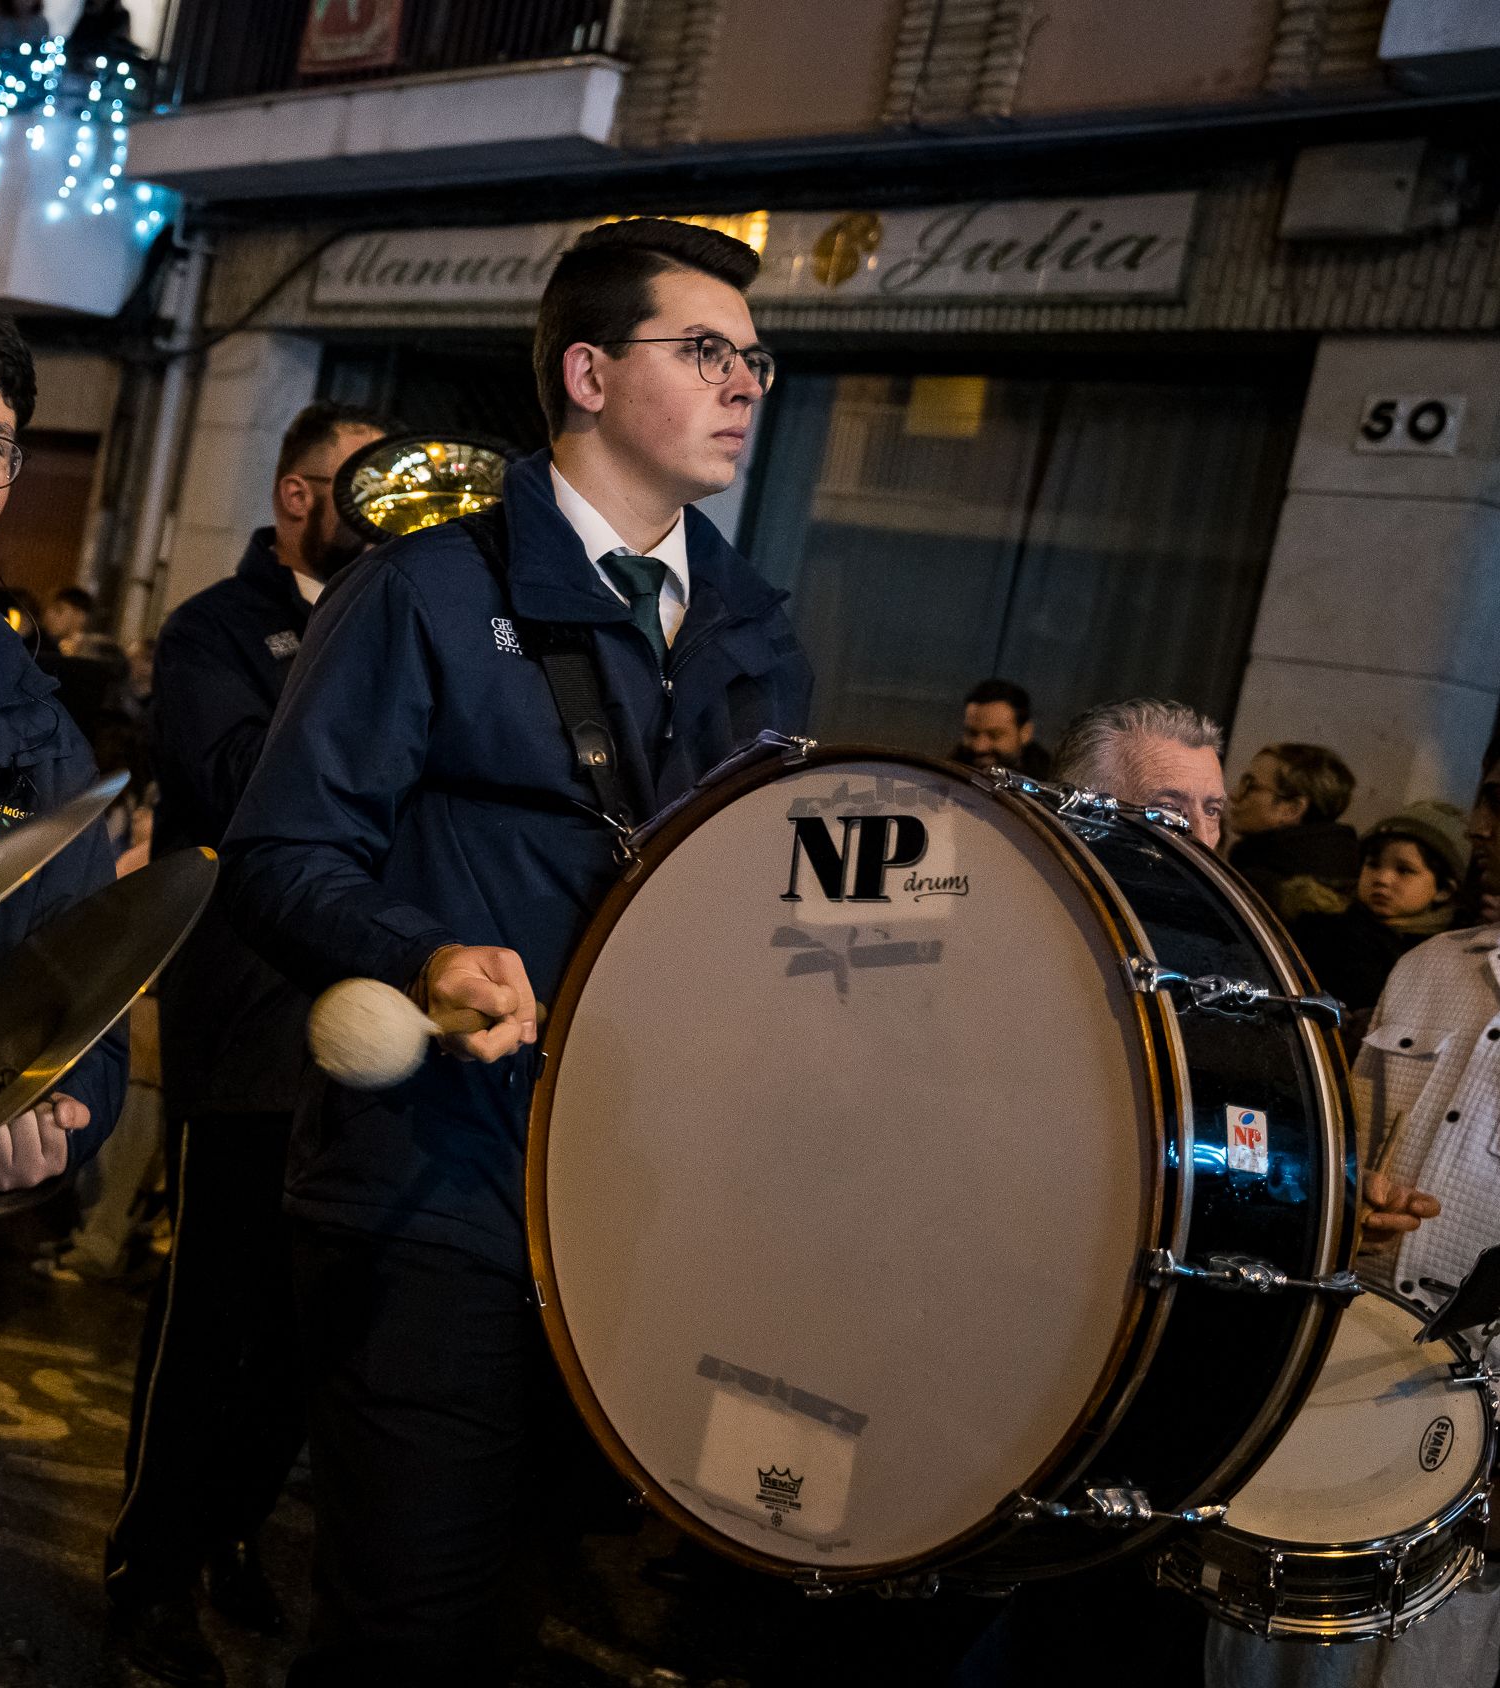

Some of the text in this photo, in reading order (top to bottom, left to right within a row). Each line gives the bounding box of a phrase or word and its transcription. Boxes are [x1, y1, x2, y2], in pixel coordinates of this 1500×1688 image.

[322, 201, 1178, 294] Manual Julia
[1362, 400, 1447, 444] 50
[494, 630, 520, 648] SE
[779, 814, 970, 903] NP drums
[1233, 1125, 1262, 1150] NP
[1425, 1422, 1450, 1467] EVANS
[764, 1477, 796, 1490] REMO
